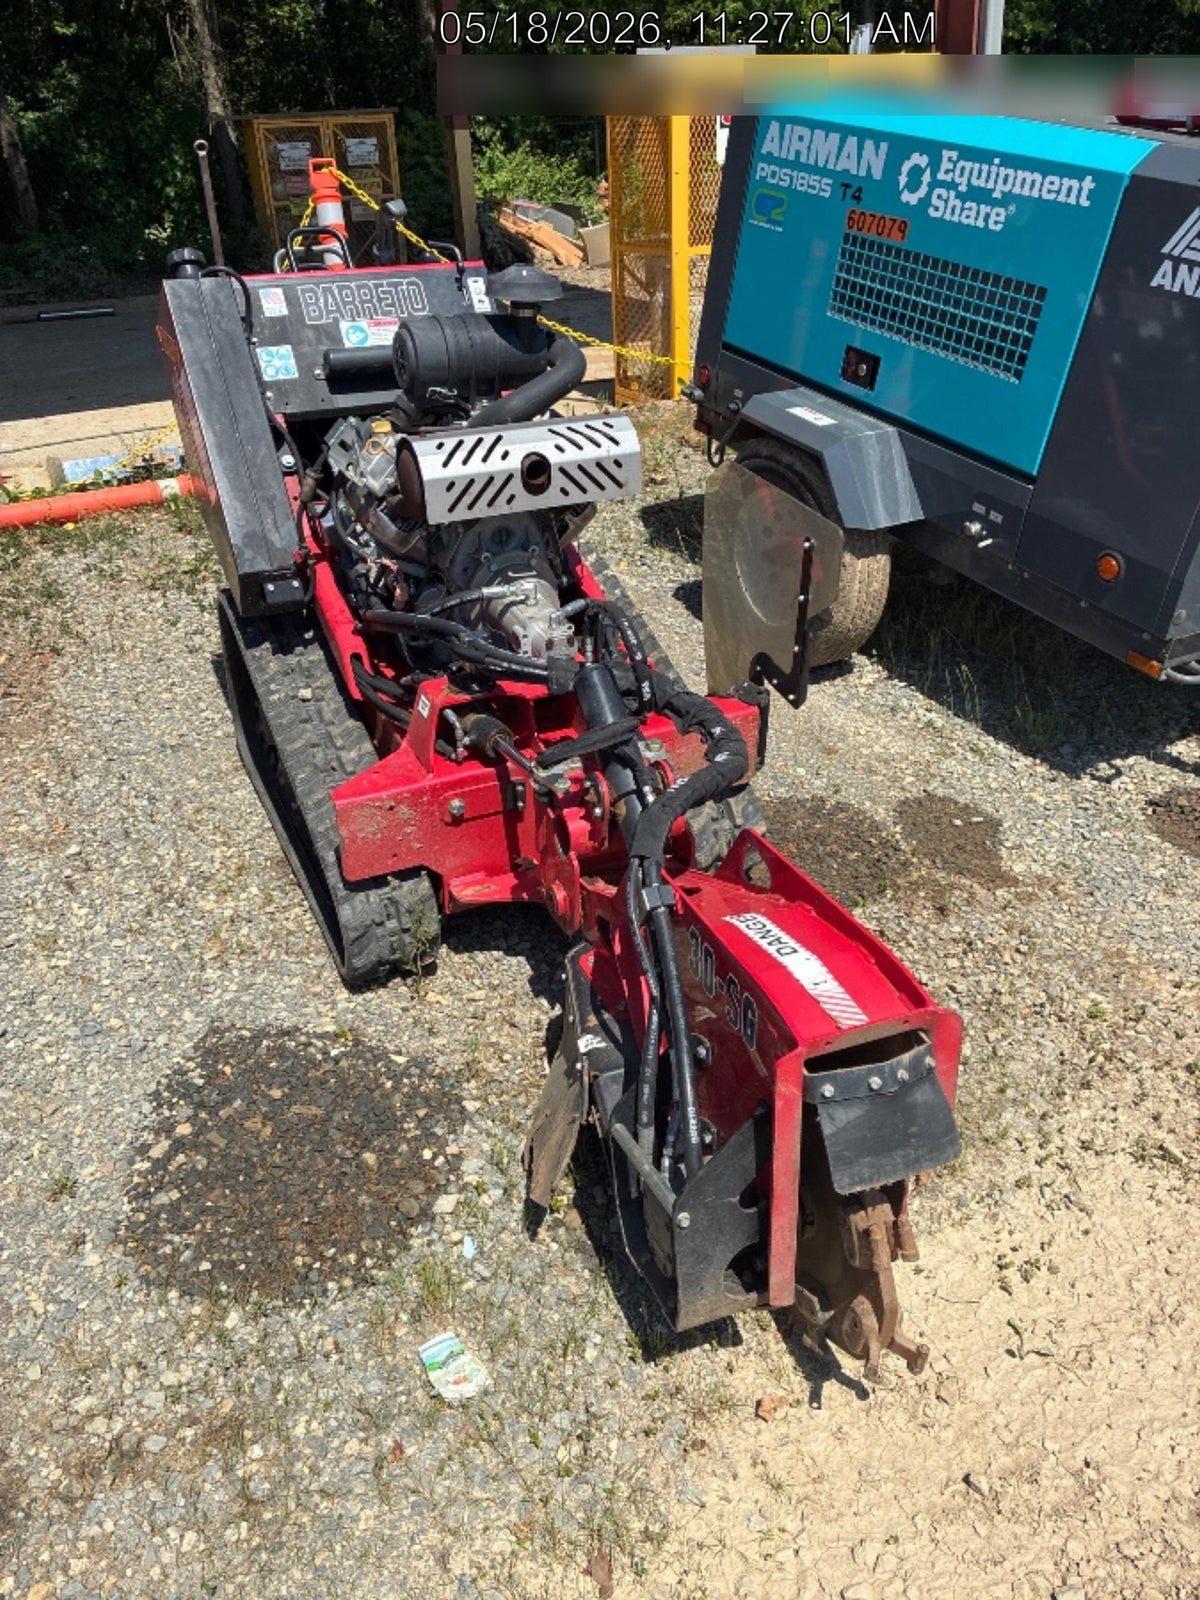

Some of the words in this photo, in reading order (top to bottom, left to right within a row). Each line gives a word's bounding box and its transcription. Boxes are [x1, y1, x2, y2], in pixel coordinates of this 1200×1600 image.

[760, 120, 888, 180] AIRMAN
[840, 182, 863, 204] T4
[937, 149, 1096, 207] Equipment
[847, 209, 908, 241] 607079
[297, 276, 428, 324] BARRETO
[1150, 259, 1200, 298] AN
